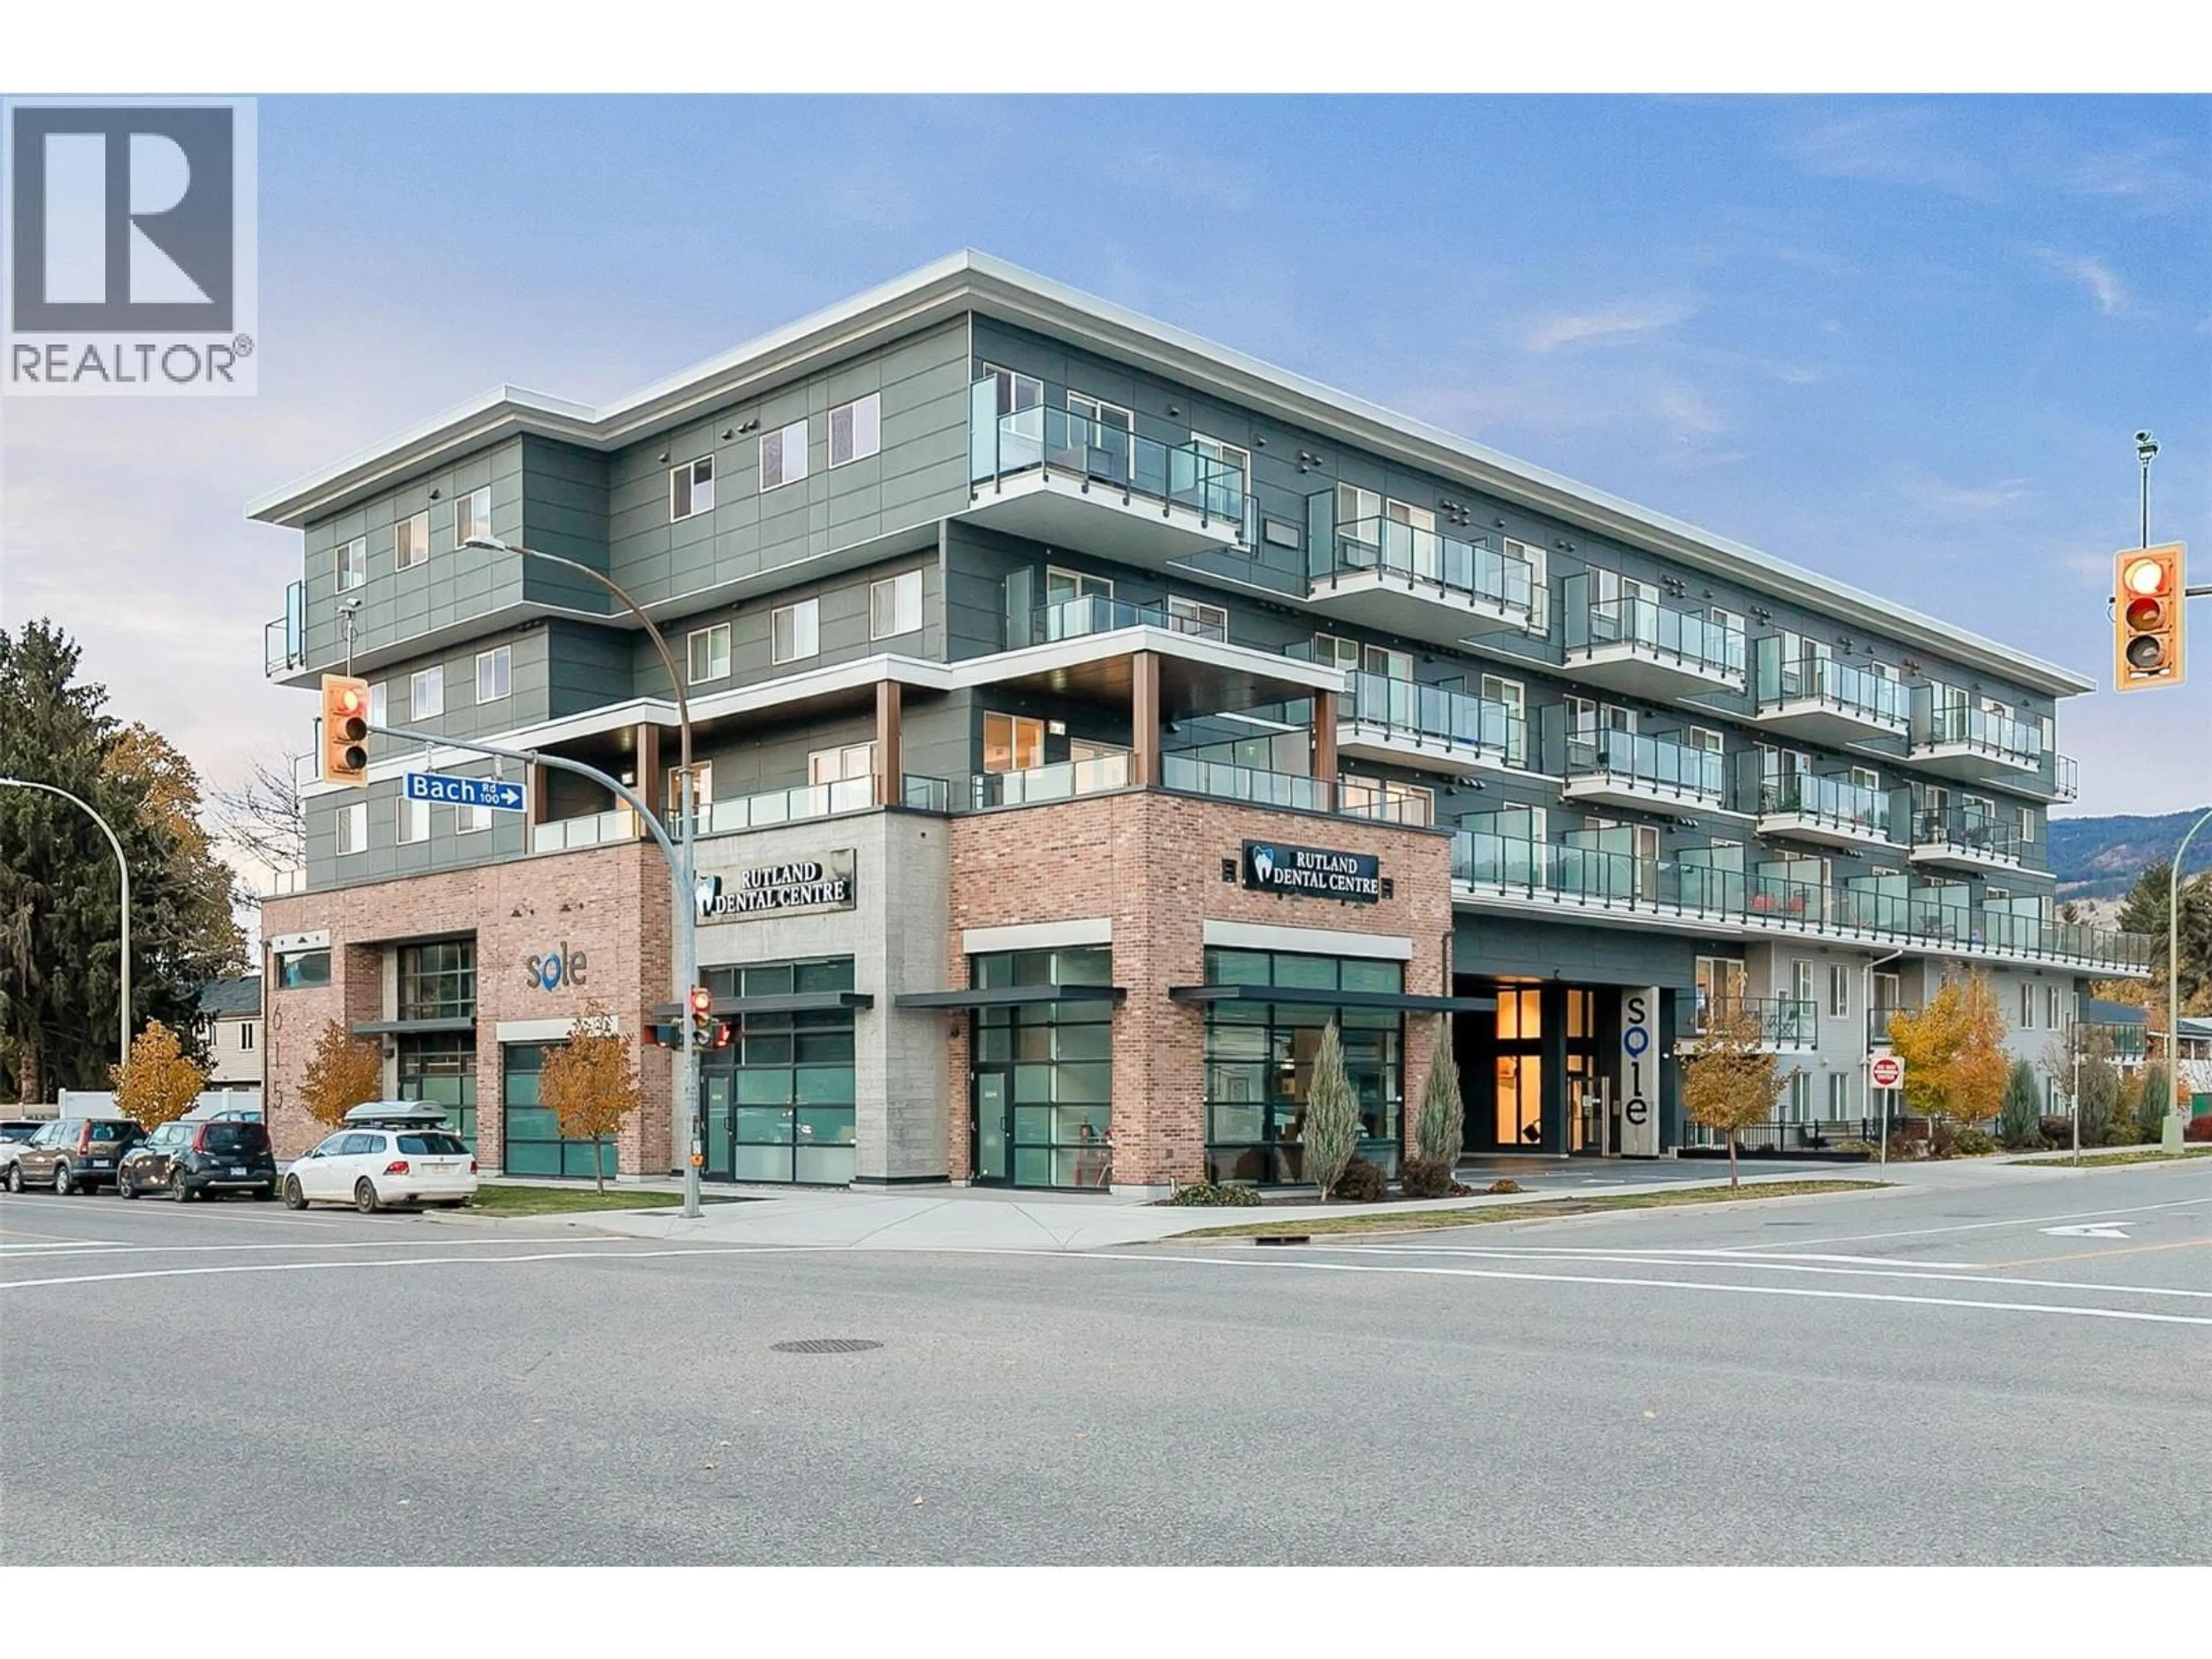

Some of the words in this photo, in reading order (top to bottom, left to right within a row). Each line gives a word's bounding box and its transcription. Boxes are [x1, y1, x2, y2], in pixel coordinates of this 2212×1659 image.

[413, 775, 475, 801] Bach
[482, 783, 497, 793] Rd
[480, 793, 500, 804] 100
[741, 861, 817, 889] RUTLAND
[1296, 851, 1358, 874] RUTLAND
[1273, 867, 1327, 889] DENTAL
[1328, 873, 1378, 894] CENTRE
[715, 889, 776, 914] DENTAL
[780, 880, 845, 907] CENTRE
[526, 941, 588, 992] sole
[1624, 997, 1649, 1126] sole
